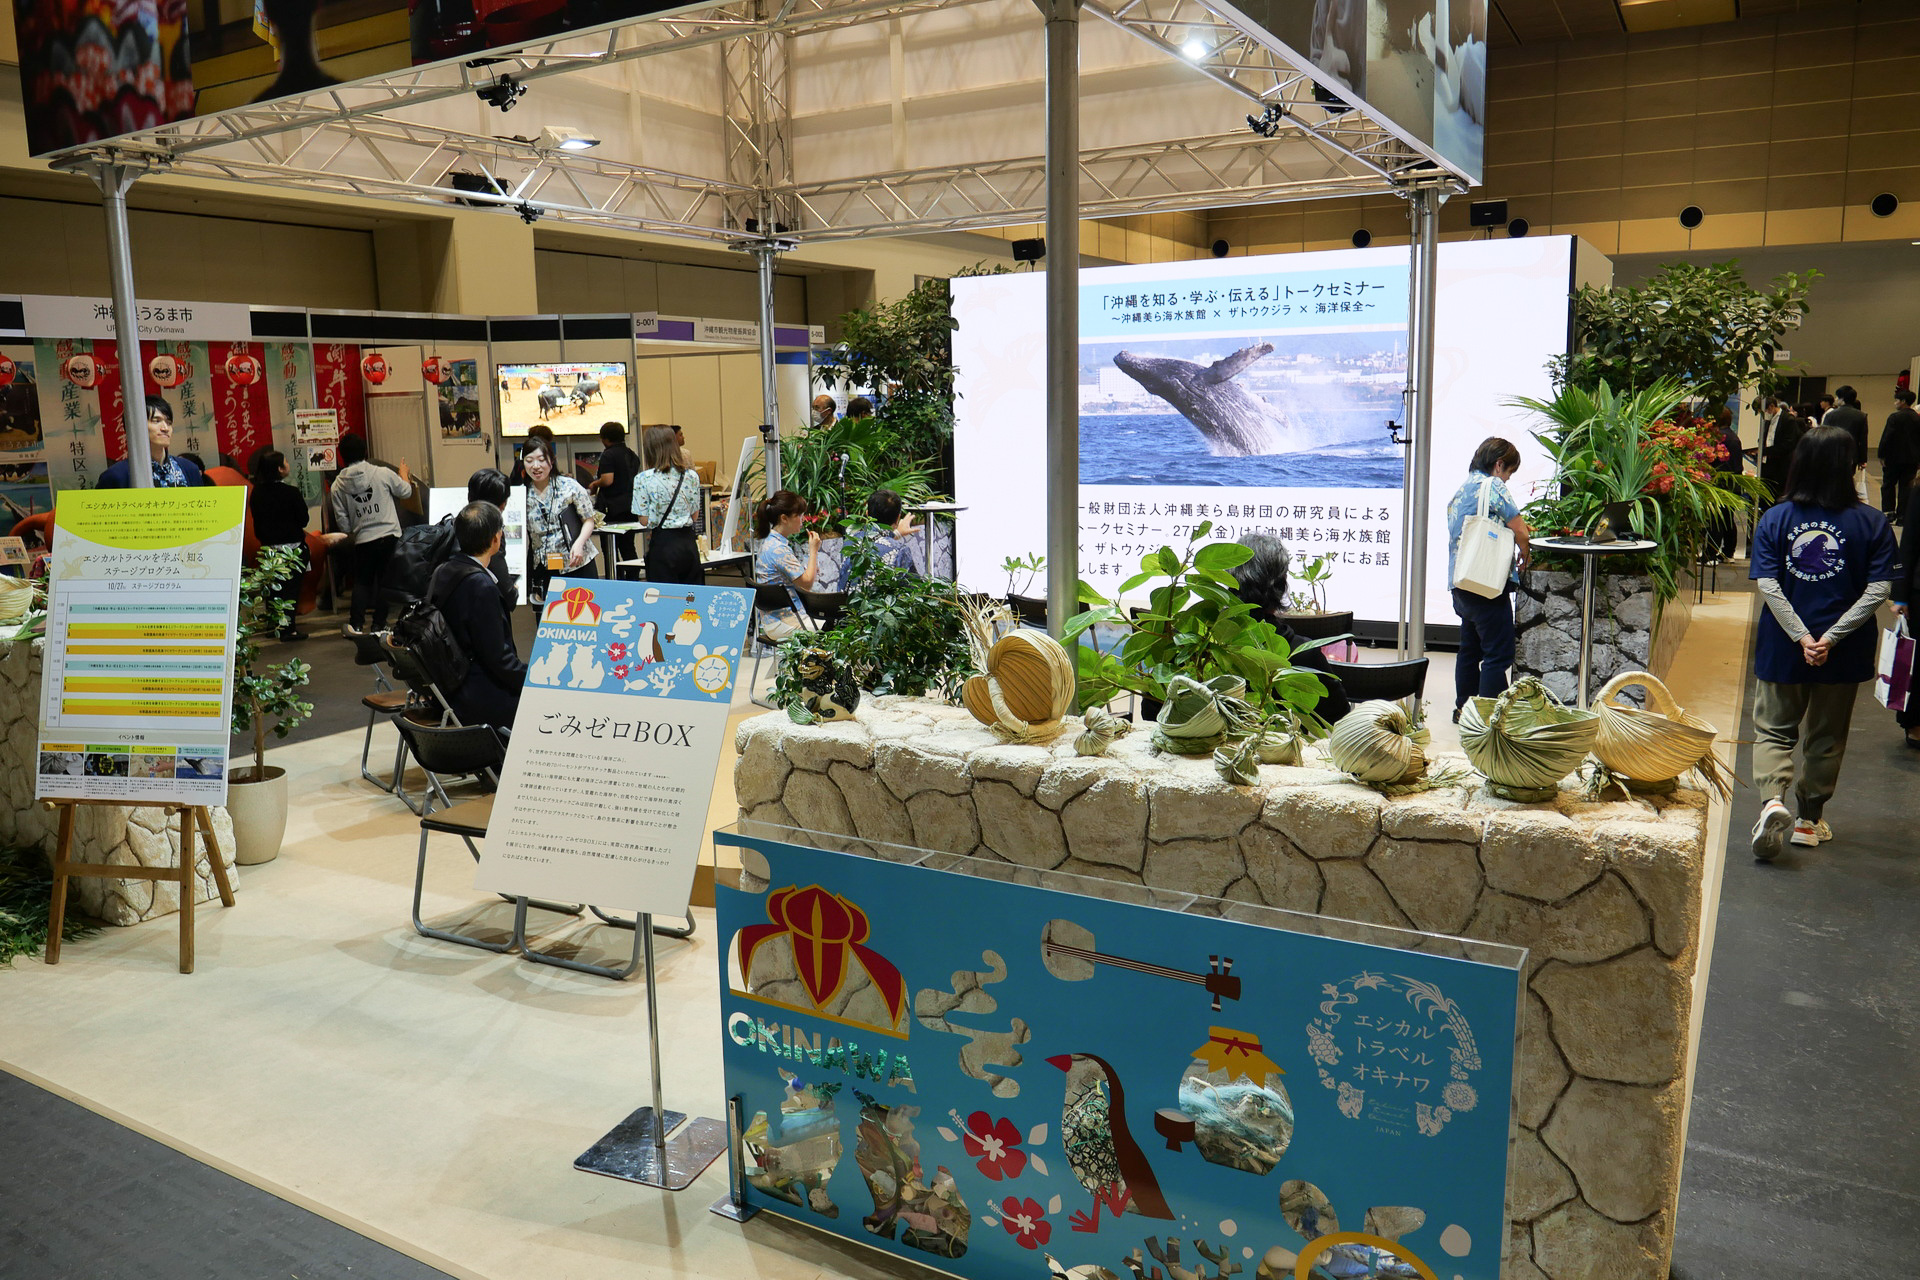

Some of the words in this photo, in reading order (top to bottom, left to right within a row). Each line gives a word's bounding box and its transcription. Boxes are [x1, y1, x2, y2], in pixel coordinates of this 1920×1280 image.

[1103, 281, 1385, 310] 「沖縄を知る・学ぶ・伝える」トークセミナー
[94, 304, 192, 322] 沖うるま市
[636, 318, 655, 326] 5-001
[84, 552, 204, 563] エシカルトラベルを学ぶ、知る
[104, 565, 180, 576] ステージプログラム
[537, 627, 597, 642] OKINAWA
[538, 712, 695, 747] ごみゼロBOX
[1354, 1015, 1436, 1039] エシカル
[728, 1012, 916, 1094] OKINAWA
[1358, 1036, 1434, 1066] トラベル
[1353, 1063, 1430, 1093] オキナワ
[1376, 1126, 1401, 1136] JAPAN
